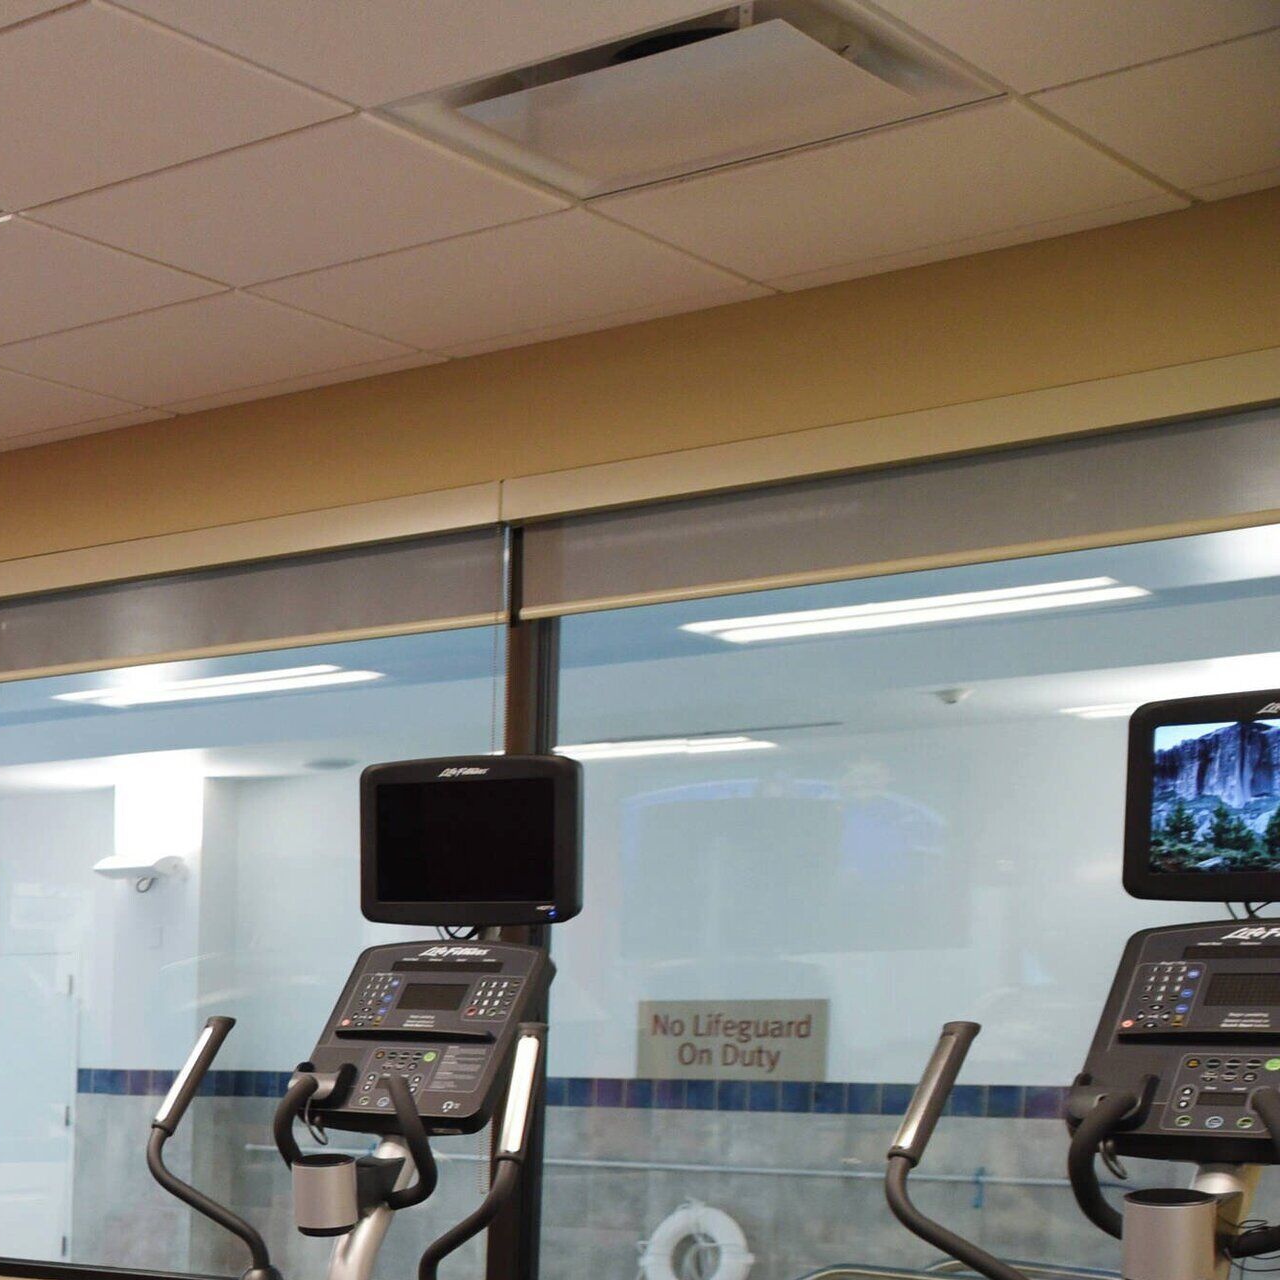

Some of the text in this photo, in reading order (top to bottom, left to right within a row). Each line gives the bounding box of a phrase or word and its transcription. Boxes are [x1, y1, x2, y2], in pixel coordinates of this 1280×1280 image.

[650, 1012, 812, 1043] No Lifeguard
[677, 1042, 781, 1073] On Duty
